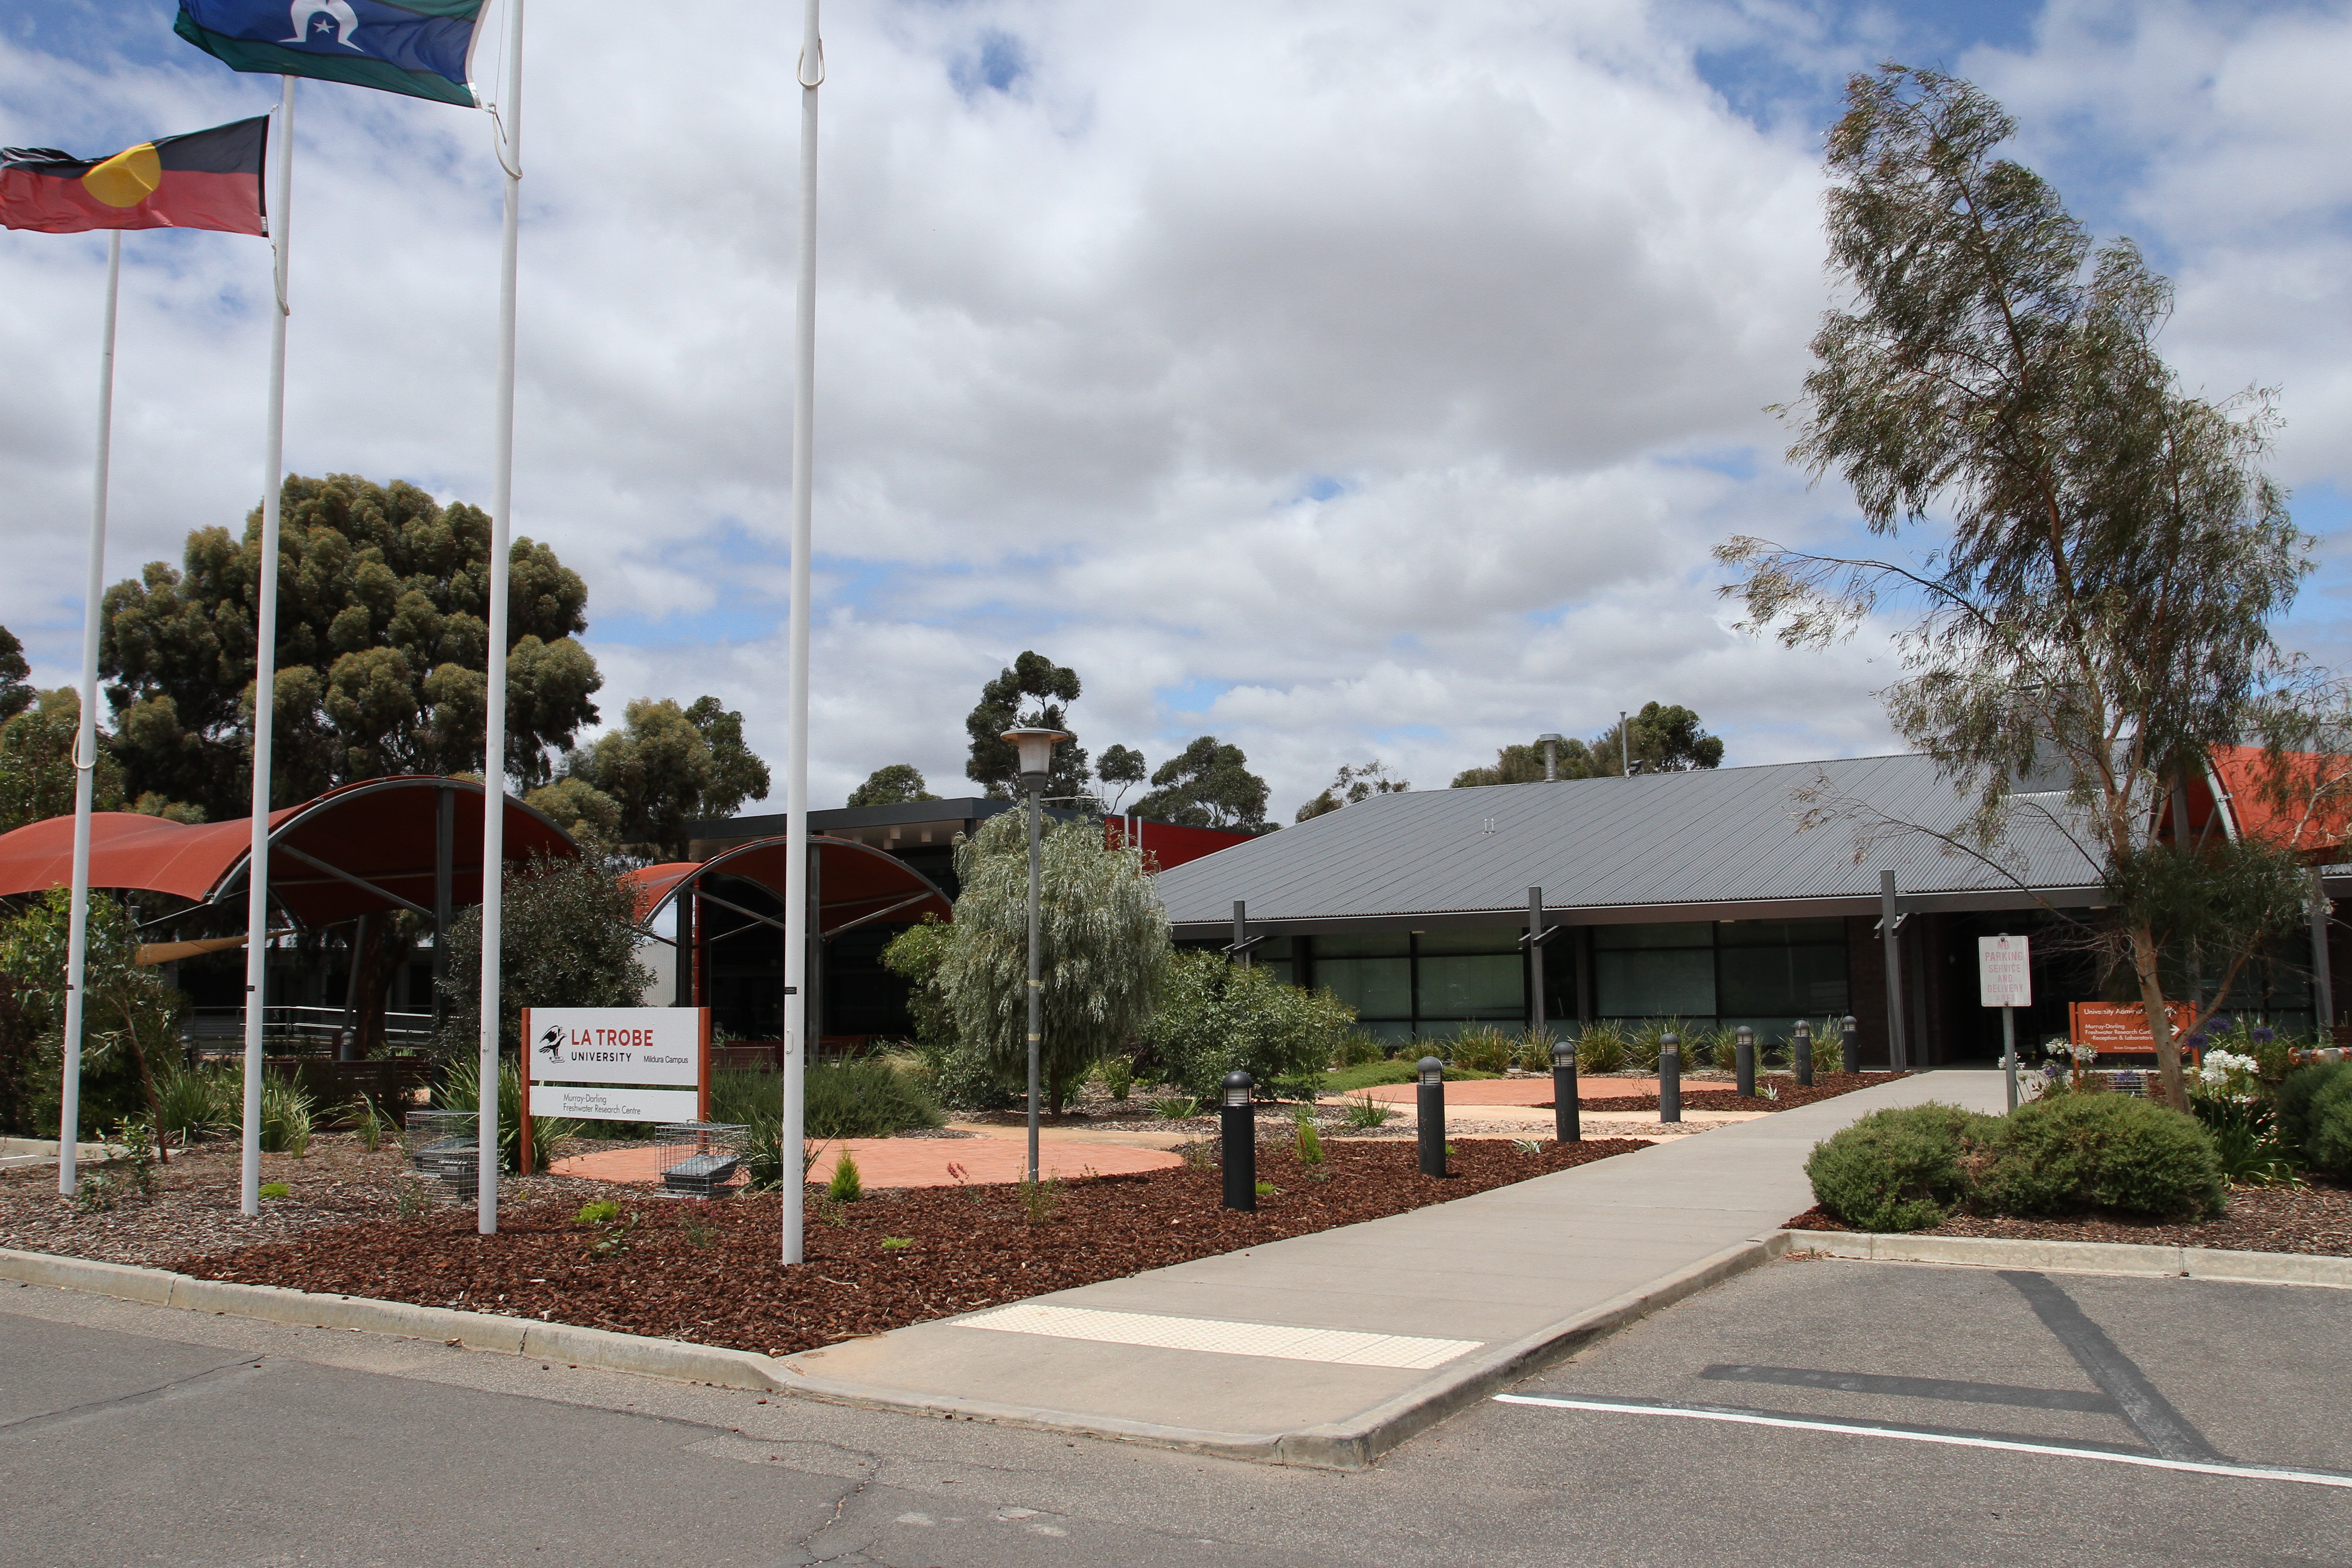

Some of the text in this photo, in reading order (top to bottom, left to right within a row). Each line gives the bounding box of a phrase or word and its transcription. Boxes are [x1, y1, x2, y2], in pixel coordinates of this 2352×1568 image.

[1998, 940, 2009, 950] NO
[1985, 951, 2023, 961] PARKING
[1989, 964, 2021, 973] SERVICE
[1988, 984, 2023, 993] DELIVERY
[1996, 994, 2016, 1002] AREA
[572, 1029, 653, 1046] LA TROBE
[572, 1052, 632, 1062] UNIVERSITY
[665, 1056, 688, 1064] Campus
[564, 1093, 607, 1105] Murray-Darling
[564, 1103, 641, 1114] Freshwater Research Centre
